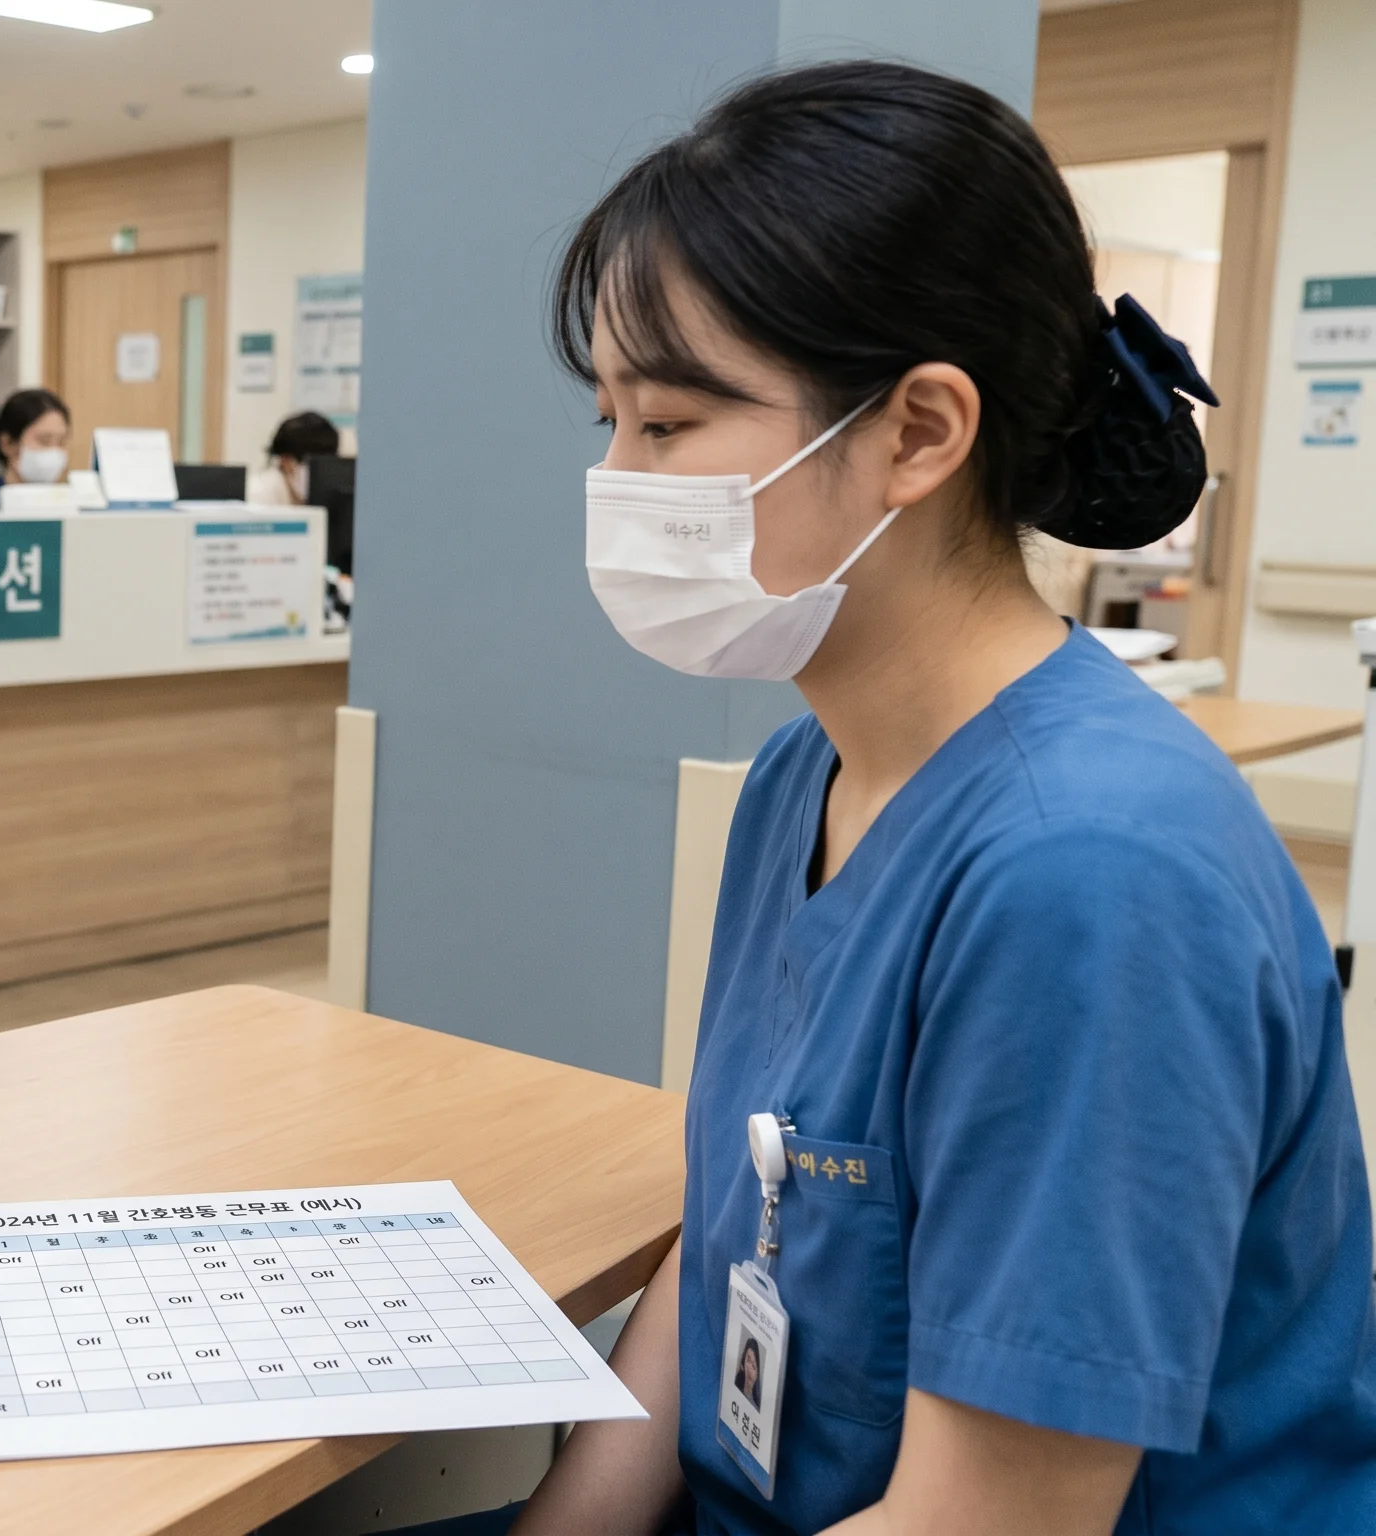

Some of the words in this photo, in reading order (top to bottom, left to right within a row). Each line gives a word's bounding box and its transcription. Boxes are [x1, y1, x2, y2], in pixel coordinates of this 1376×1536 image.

[664, 522, 711, 541] 이수진
[798, 1152, 868, 1185] 이수진
[67, 1210, 121, 1224] 11월
[127, 1205, 218, 1222] 간호병동
[225, 1201, 294, 1217] 근무표
[300, 1197, 362, 1214] (예시)
[339, 1237, 360, 1245] Off
[252, 1257, 277, 1266] Off
[260, 1273, 285, 1282] Off
[310, 1270, 335, 1279] Off
[470, 1276, 495, 1285] Off
[59, 1285, 84, 1293] Off
[219, 1292, 244, 1301] Off
[382, 1299, 408, 1308] Off
[280, 1305, 305, 1315] Off
[125, 1315, 150, 1325] Off
[344, 1319, 369, 1329] Off
[76, 1337, 102, 1346] Off
[407, 1334, 433, 1344] Off
[195, 1348, 221, 1358] Off
[313, 1359, 340, 1369] Off
[367, 1356, 393, 1366] Off
[258, 1363, 284, 1373] Off
[146, 1371, 172, 1381] Off
[36, 1379, 62, 1388] Off
